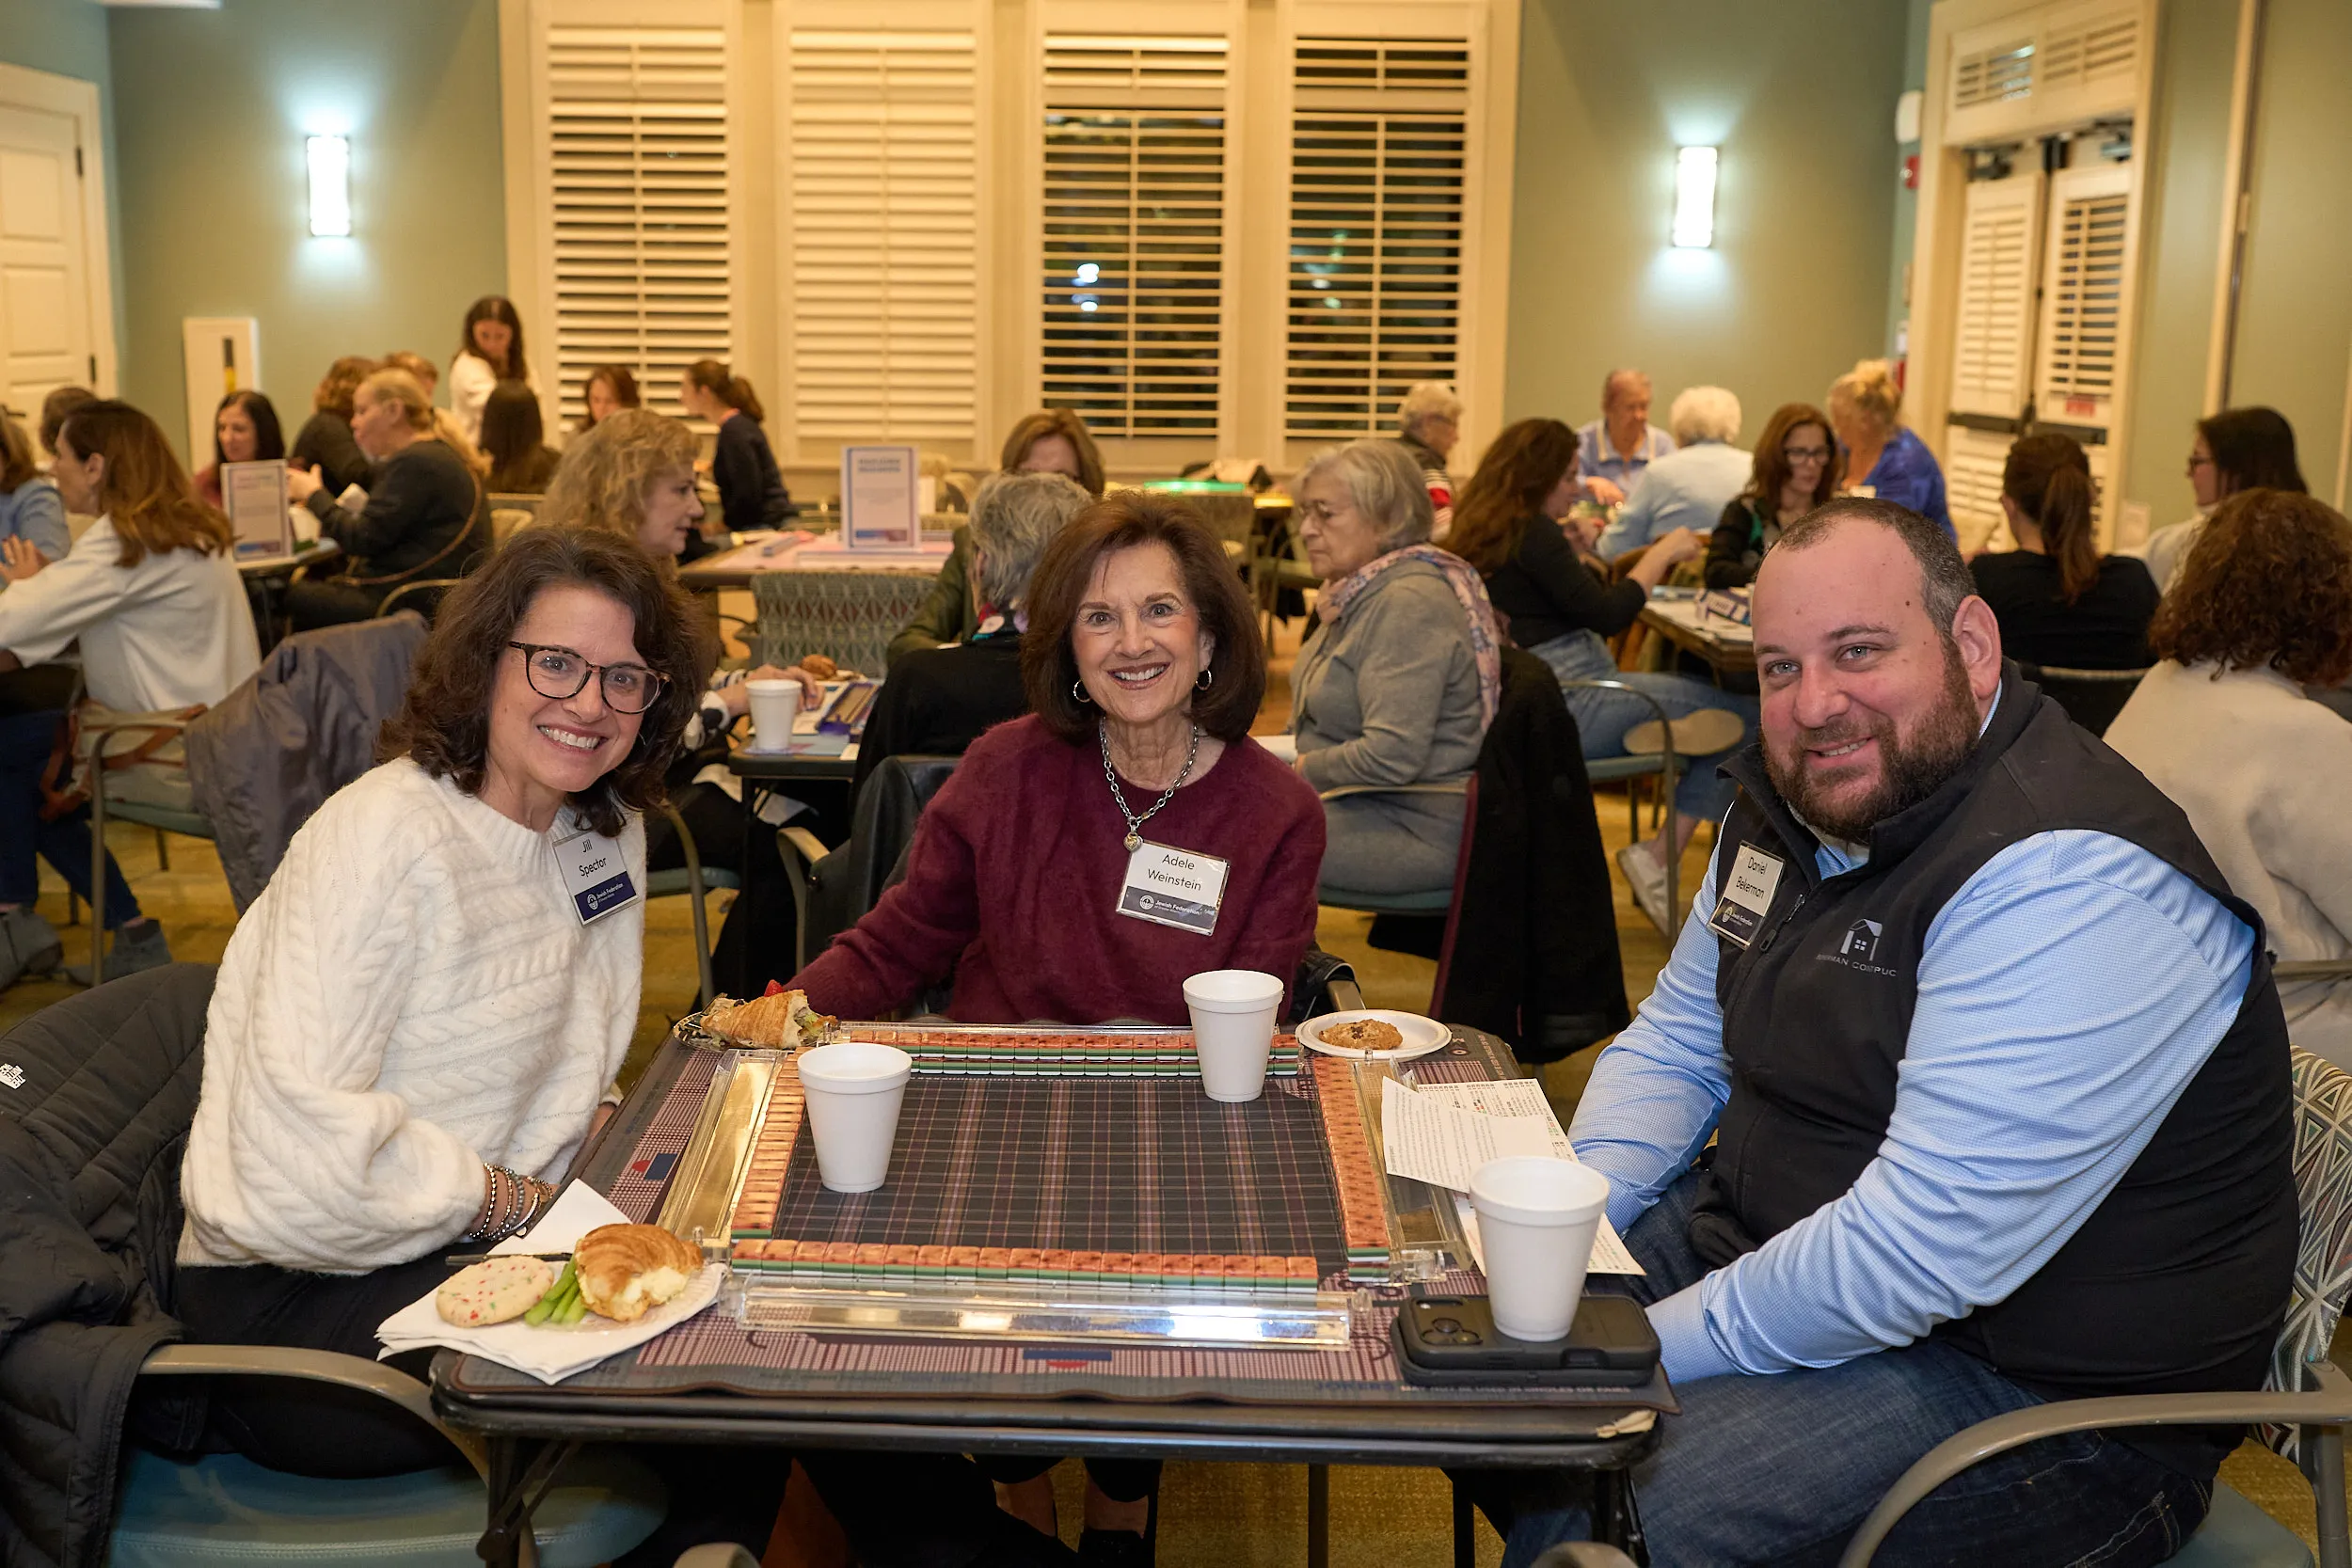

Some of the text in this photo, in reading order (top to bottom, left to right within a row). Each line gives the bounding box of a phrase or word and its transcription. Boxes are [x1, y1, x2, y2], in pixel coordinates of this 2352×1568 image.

[581, 838, 593, 853] Jill
[579, 857, 607, 878] Spector
[1162, 854, 1195, 870] Adele
[1747, 856, 1768, 875] Daniel
[1148, 868, 1201, 891] Weinstein
[1736, 876, 1765, 899] Bekerman
[1155, 899, 1172, 909] Jewish
[1172, 904, 1200, 915] Federation
